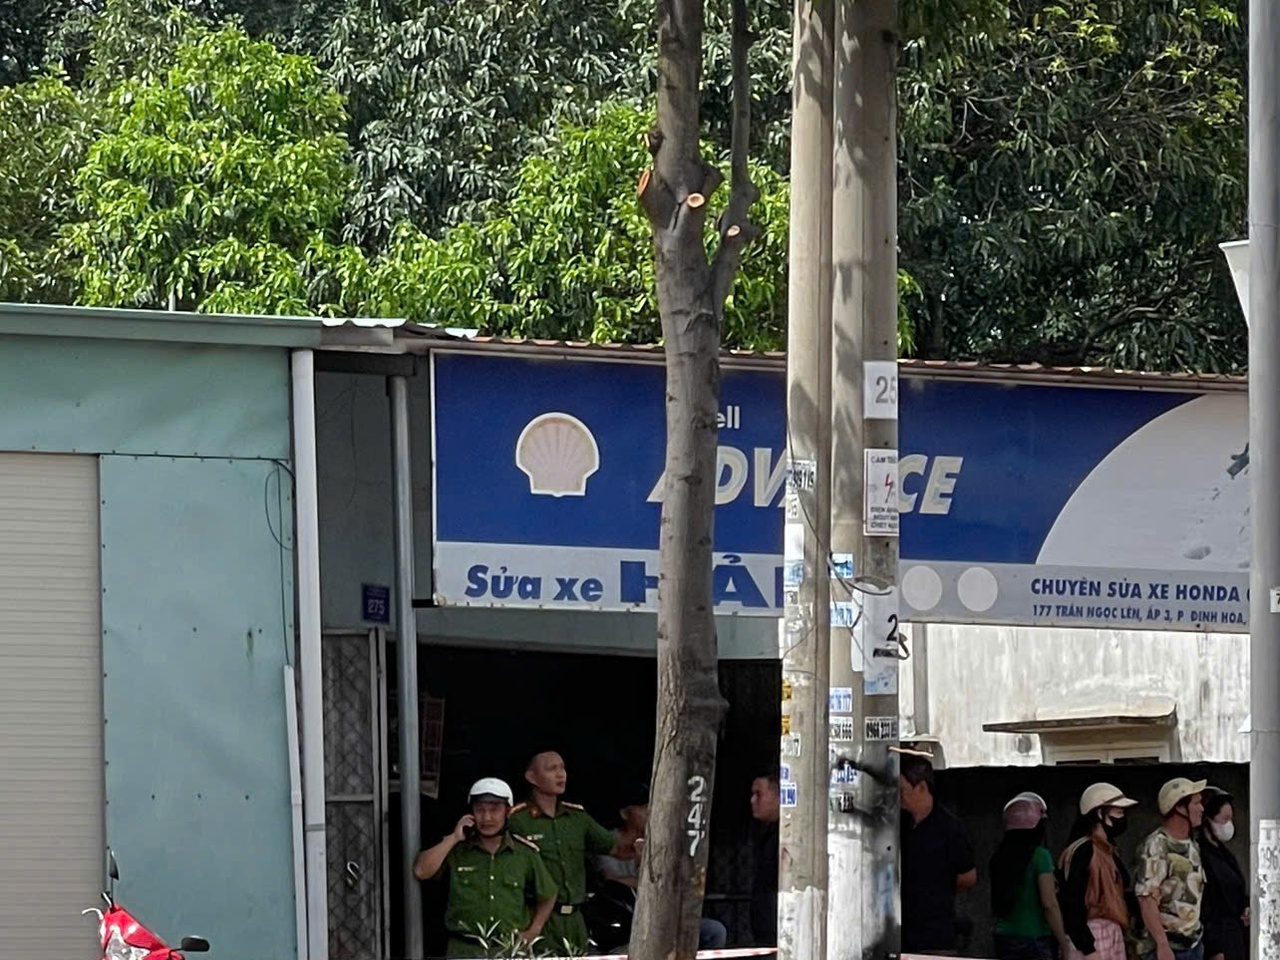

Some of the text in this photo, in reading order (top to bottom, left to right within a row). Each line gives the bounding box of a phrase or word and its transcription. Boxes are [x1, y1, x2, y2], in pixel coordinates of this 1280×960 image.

[464, 564, 542, 600] Sửa
[553, 577, 604, 602] xe
[1031, 576, 1101, 597] CHUYÊN
[1107, 578, 1142, 599] SỬA
[1148, 583, 1169, 600] XE
[1176, 584, 1240, 602] HONDA
[1033, 604, 1053, 617] 177
[687, 775, 707, 857] 247
